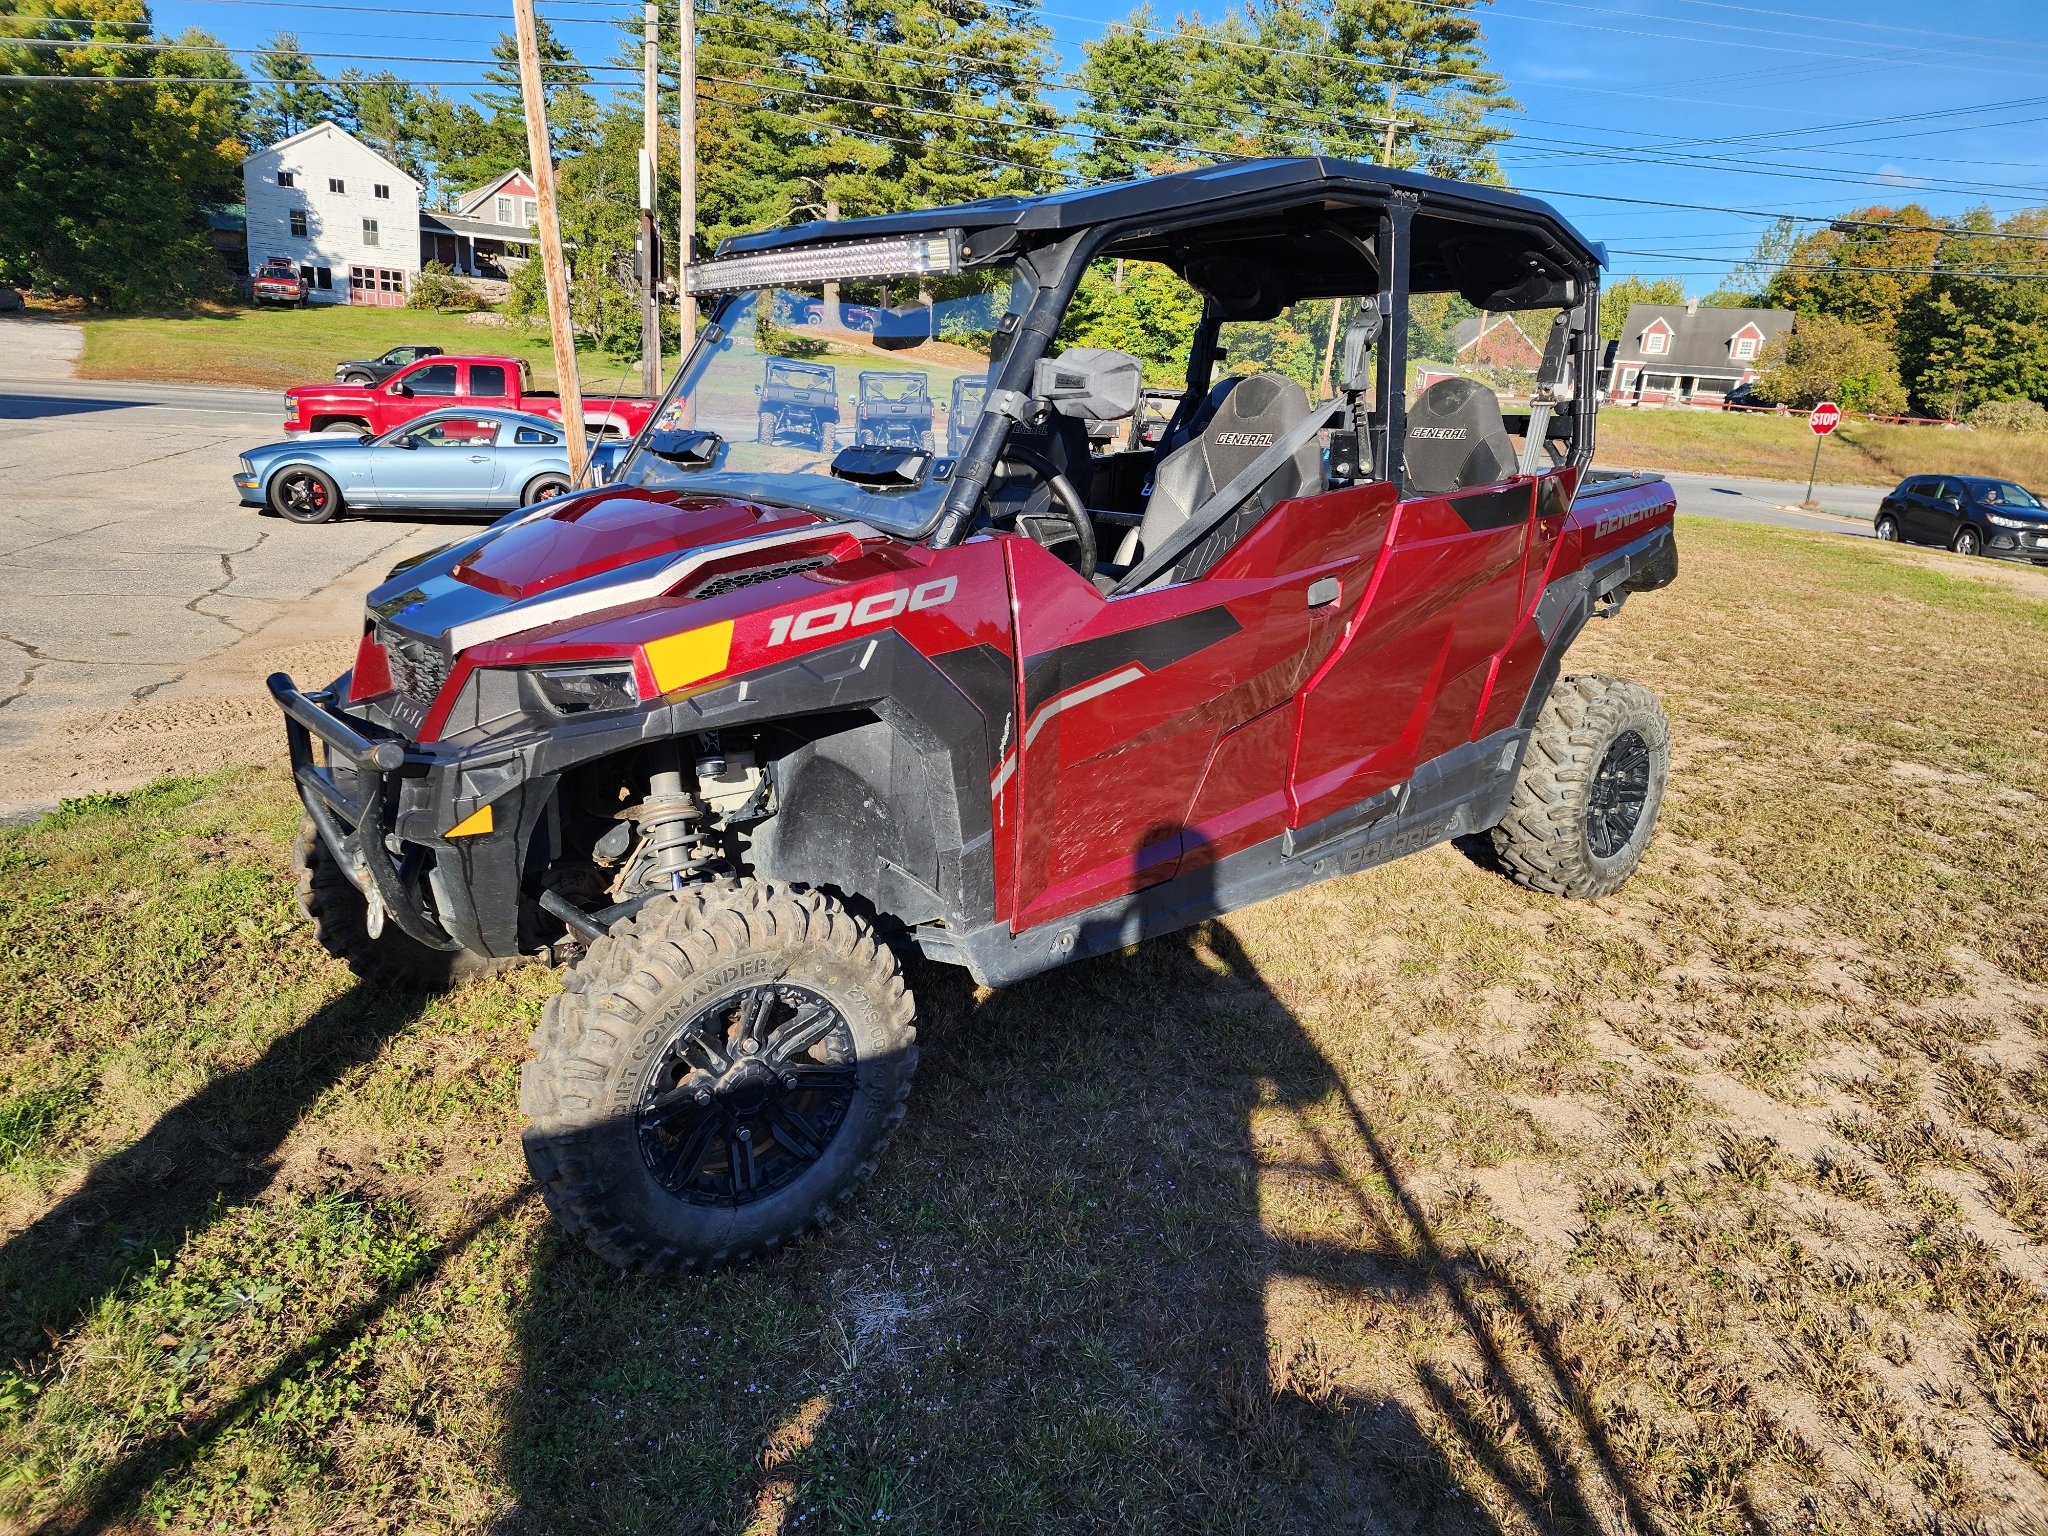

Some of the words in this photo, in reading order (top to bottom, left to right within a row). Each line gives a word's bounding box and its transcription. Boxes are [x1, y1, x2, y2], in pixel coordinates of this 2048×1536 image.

[1215, 432, 1274, 447] GENERAL
[1409, 427, 1468, 440] GENERAL
[1811, 412, 1838, 426] STOP
[1594, 494, 1669, 540] GENERAL
[766, 575, 959, 647] 1000
[1343, 819, 1445, 873] POLARIS
[631, 957, 768, 1062] COMMANDER
